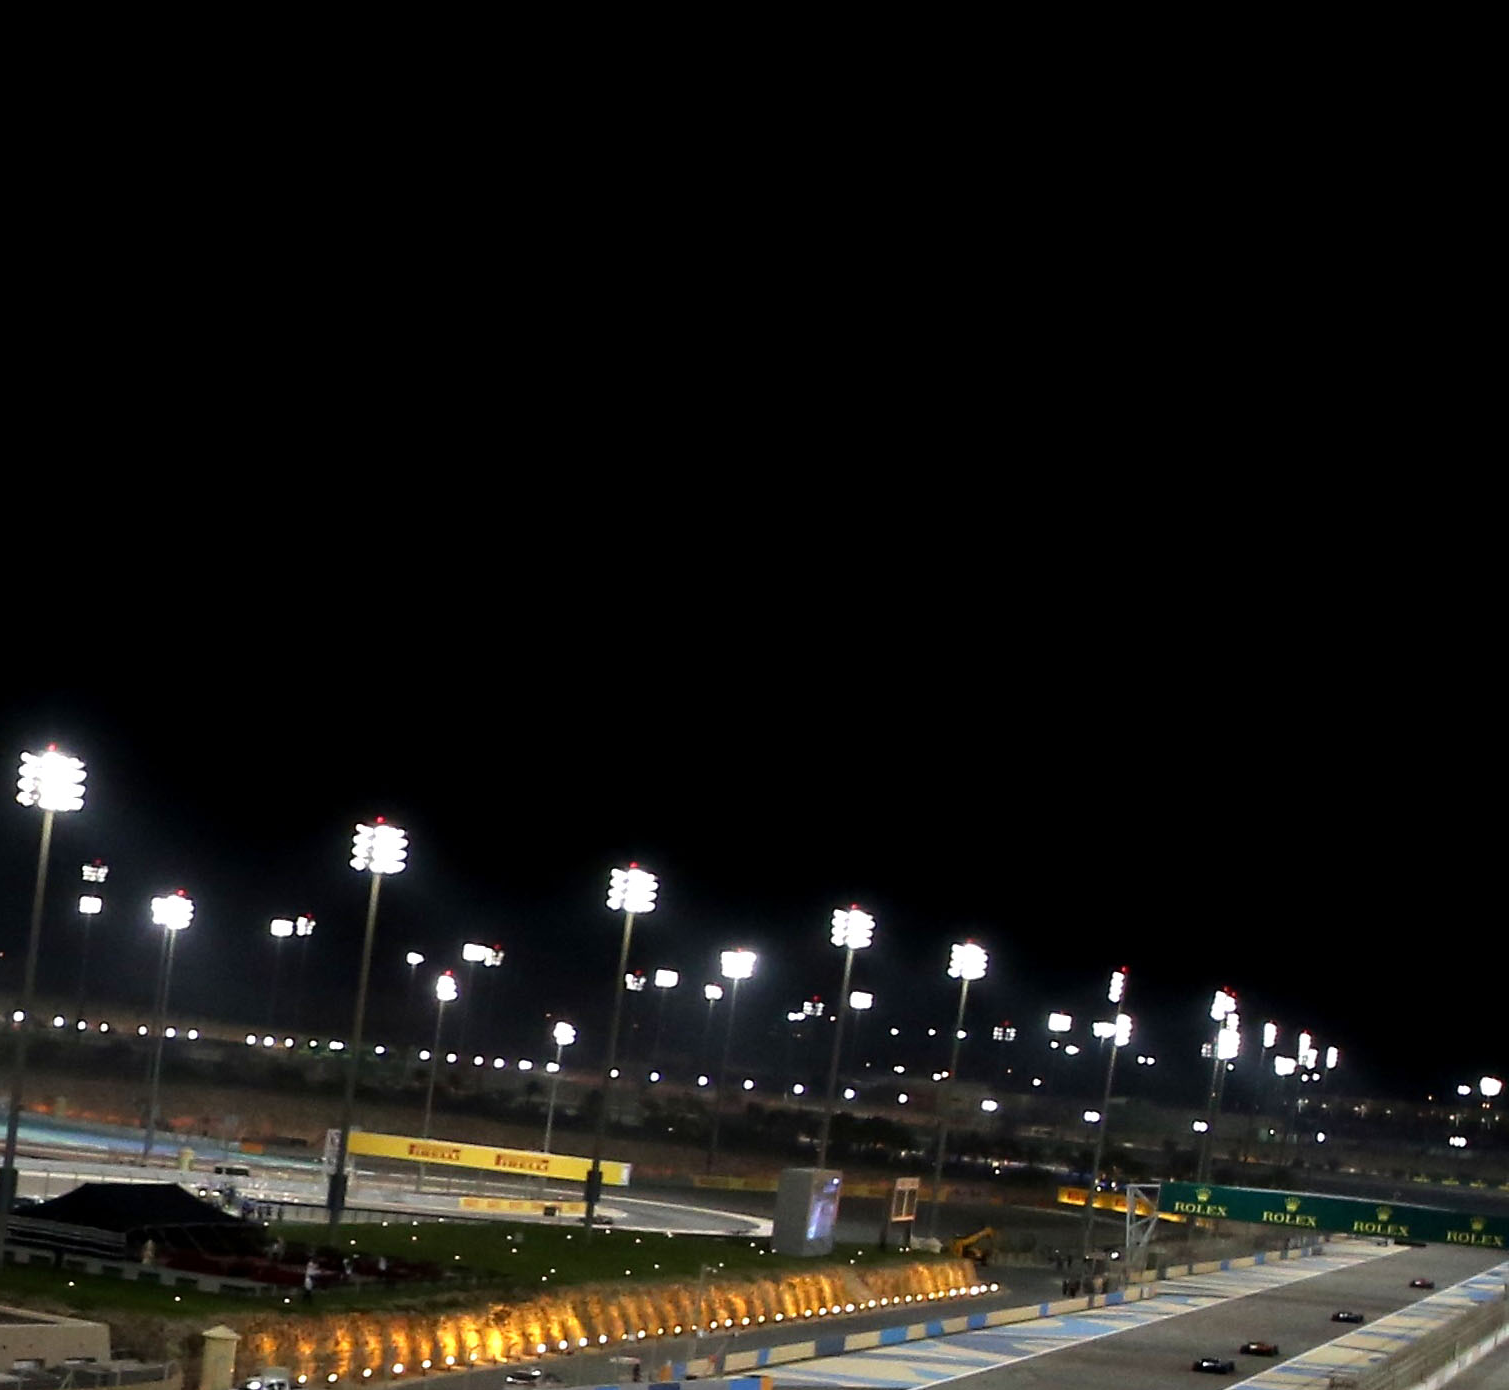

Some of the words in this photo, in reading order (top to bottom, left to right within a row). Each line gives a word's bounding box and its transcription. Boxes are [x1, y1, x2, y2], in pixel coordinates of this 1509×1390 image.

[1173, 1201, 1228, 1217] ROLEX
[1262, 1211, 1317, 1228] ROLEX
[1353, 1220, 1410, 1237] ROLEX
[1446, 1230, 1504, 1247] ROLEX
